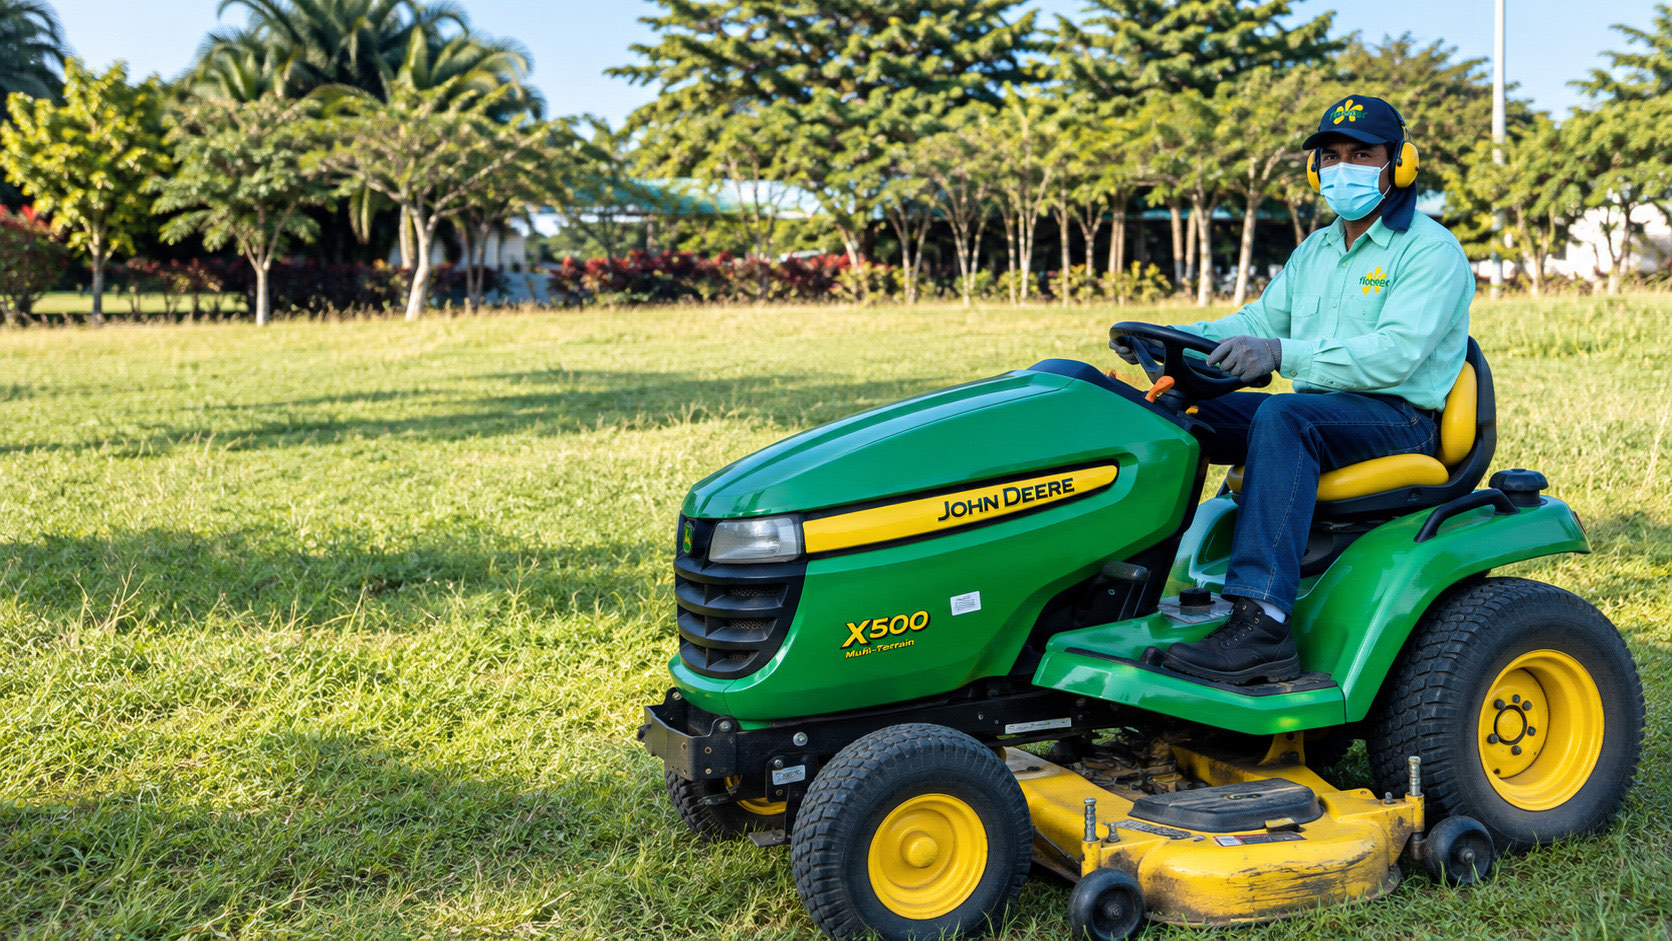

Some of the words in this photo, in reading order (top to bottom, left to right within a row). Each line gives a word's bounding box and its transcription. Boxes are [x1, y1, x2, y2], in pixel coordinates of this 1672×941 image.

[938, 495, 999, 522] JOHN
[1003, 477, 1075, 507] DEERE
[840, 610, 930, 650] X500
[845, 639, 915, 659] Multi-Terrain
